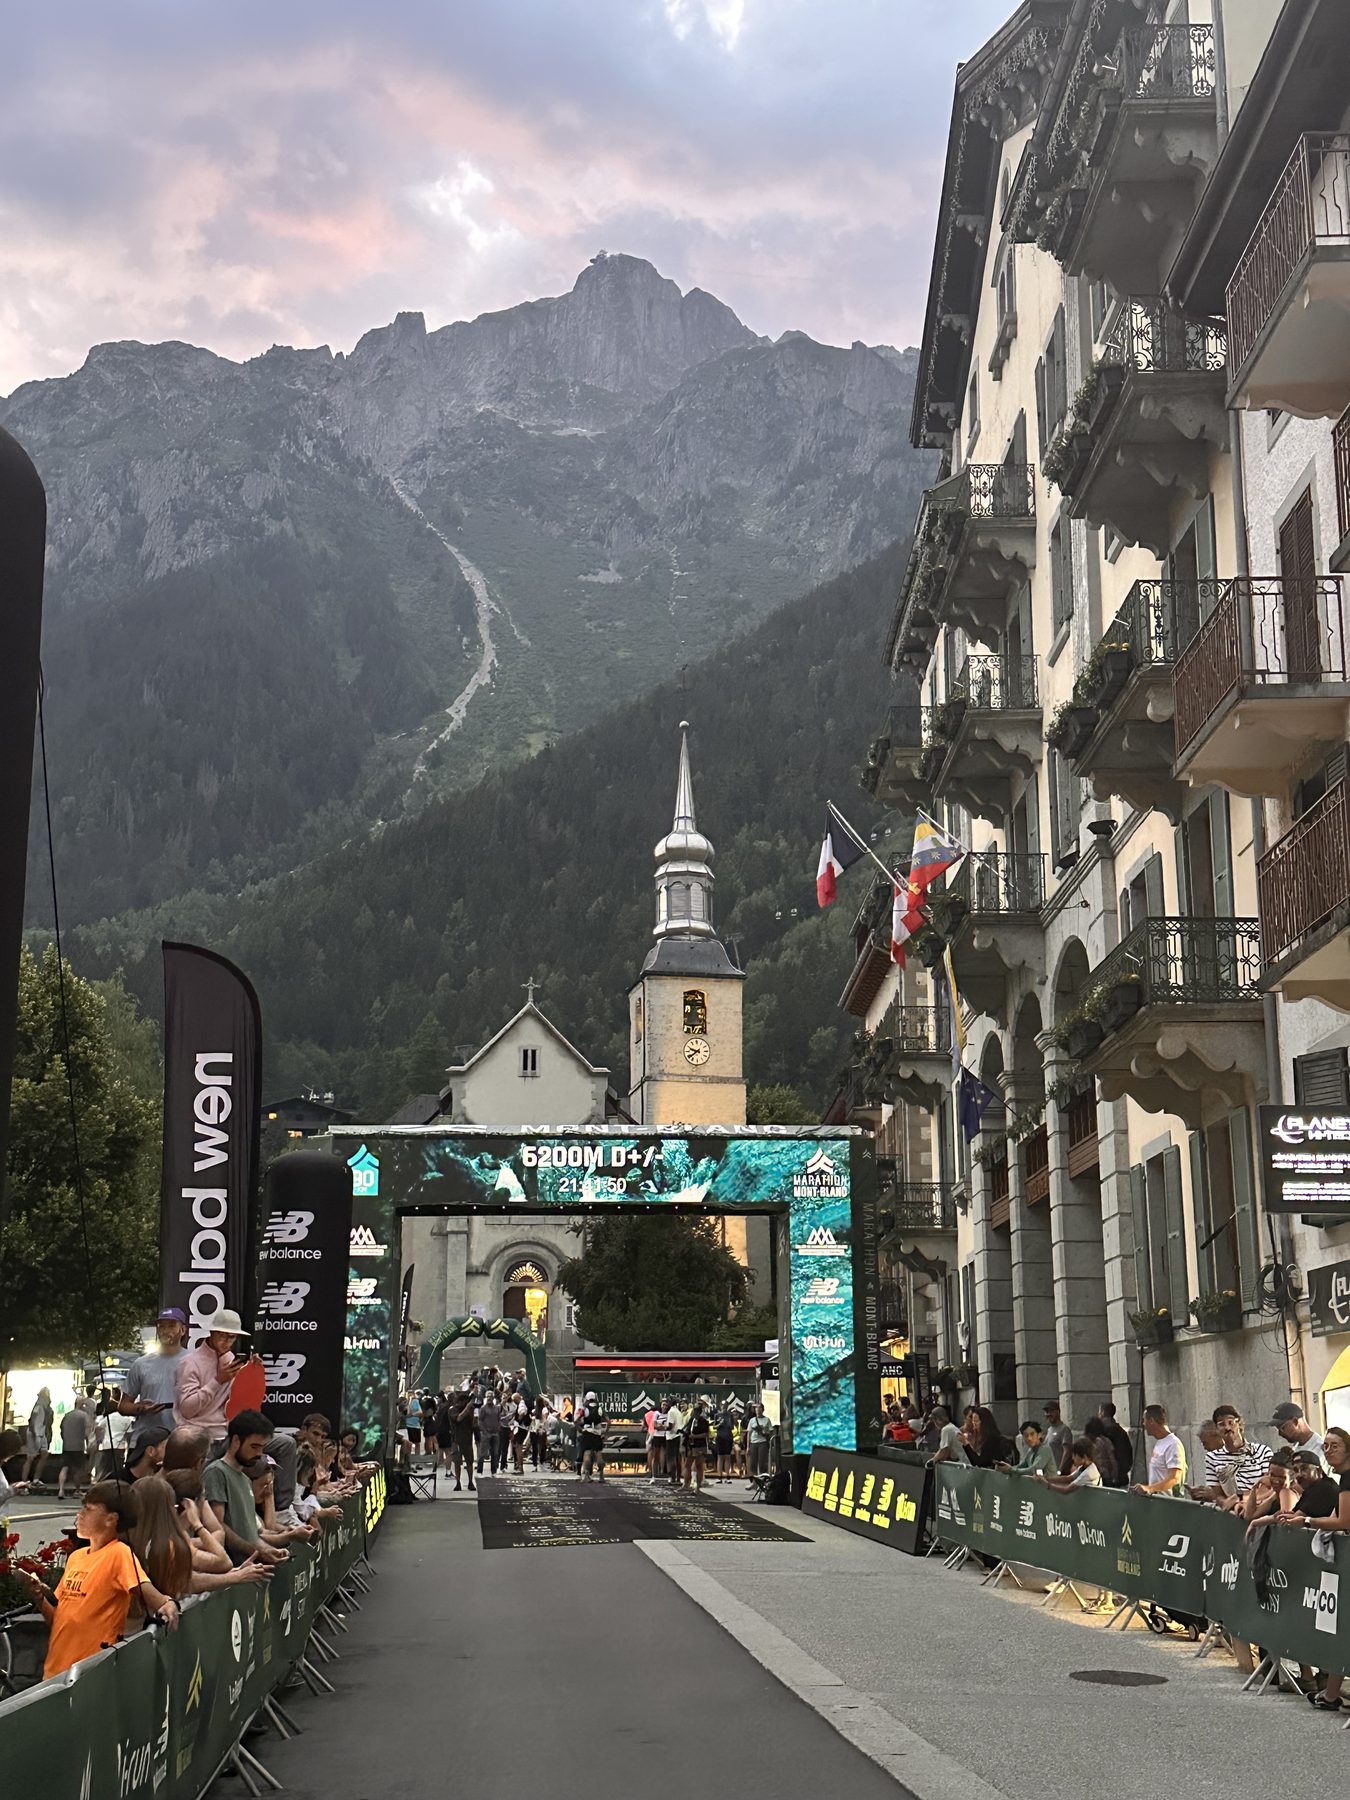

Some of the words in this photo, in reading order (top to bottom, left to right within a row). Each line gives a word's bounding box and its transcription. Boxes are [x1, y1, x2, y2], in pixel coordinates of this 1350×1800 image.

[522, 1146, 603, 1167] 6200M
[793, 1175, 847, 1186] MARATHON
[863, 1203, 875, 1275] MARATHON
[269, 1247, 322, 1260] balance
[265, 1318, 318, 1331] balance
[1158, 1559, 1187, 1577] Julbo
[1303, 1587, 1337, 1614] NHCO
